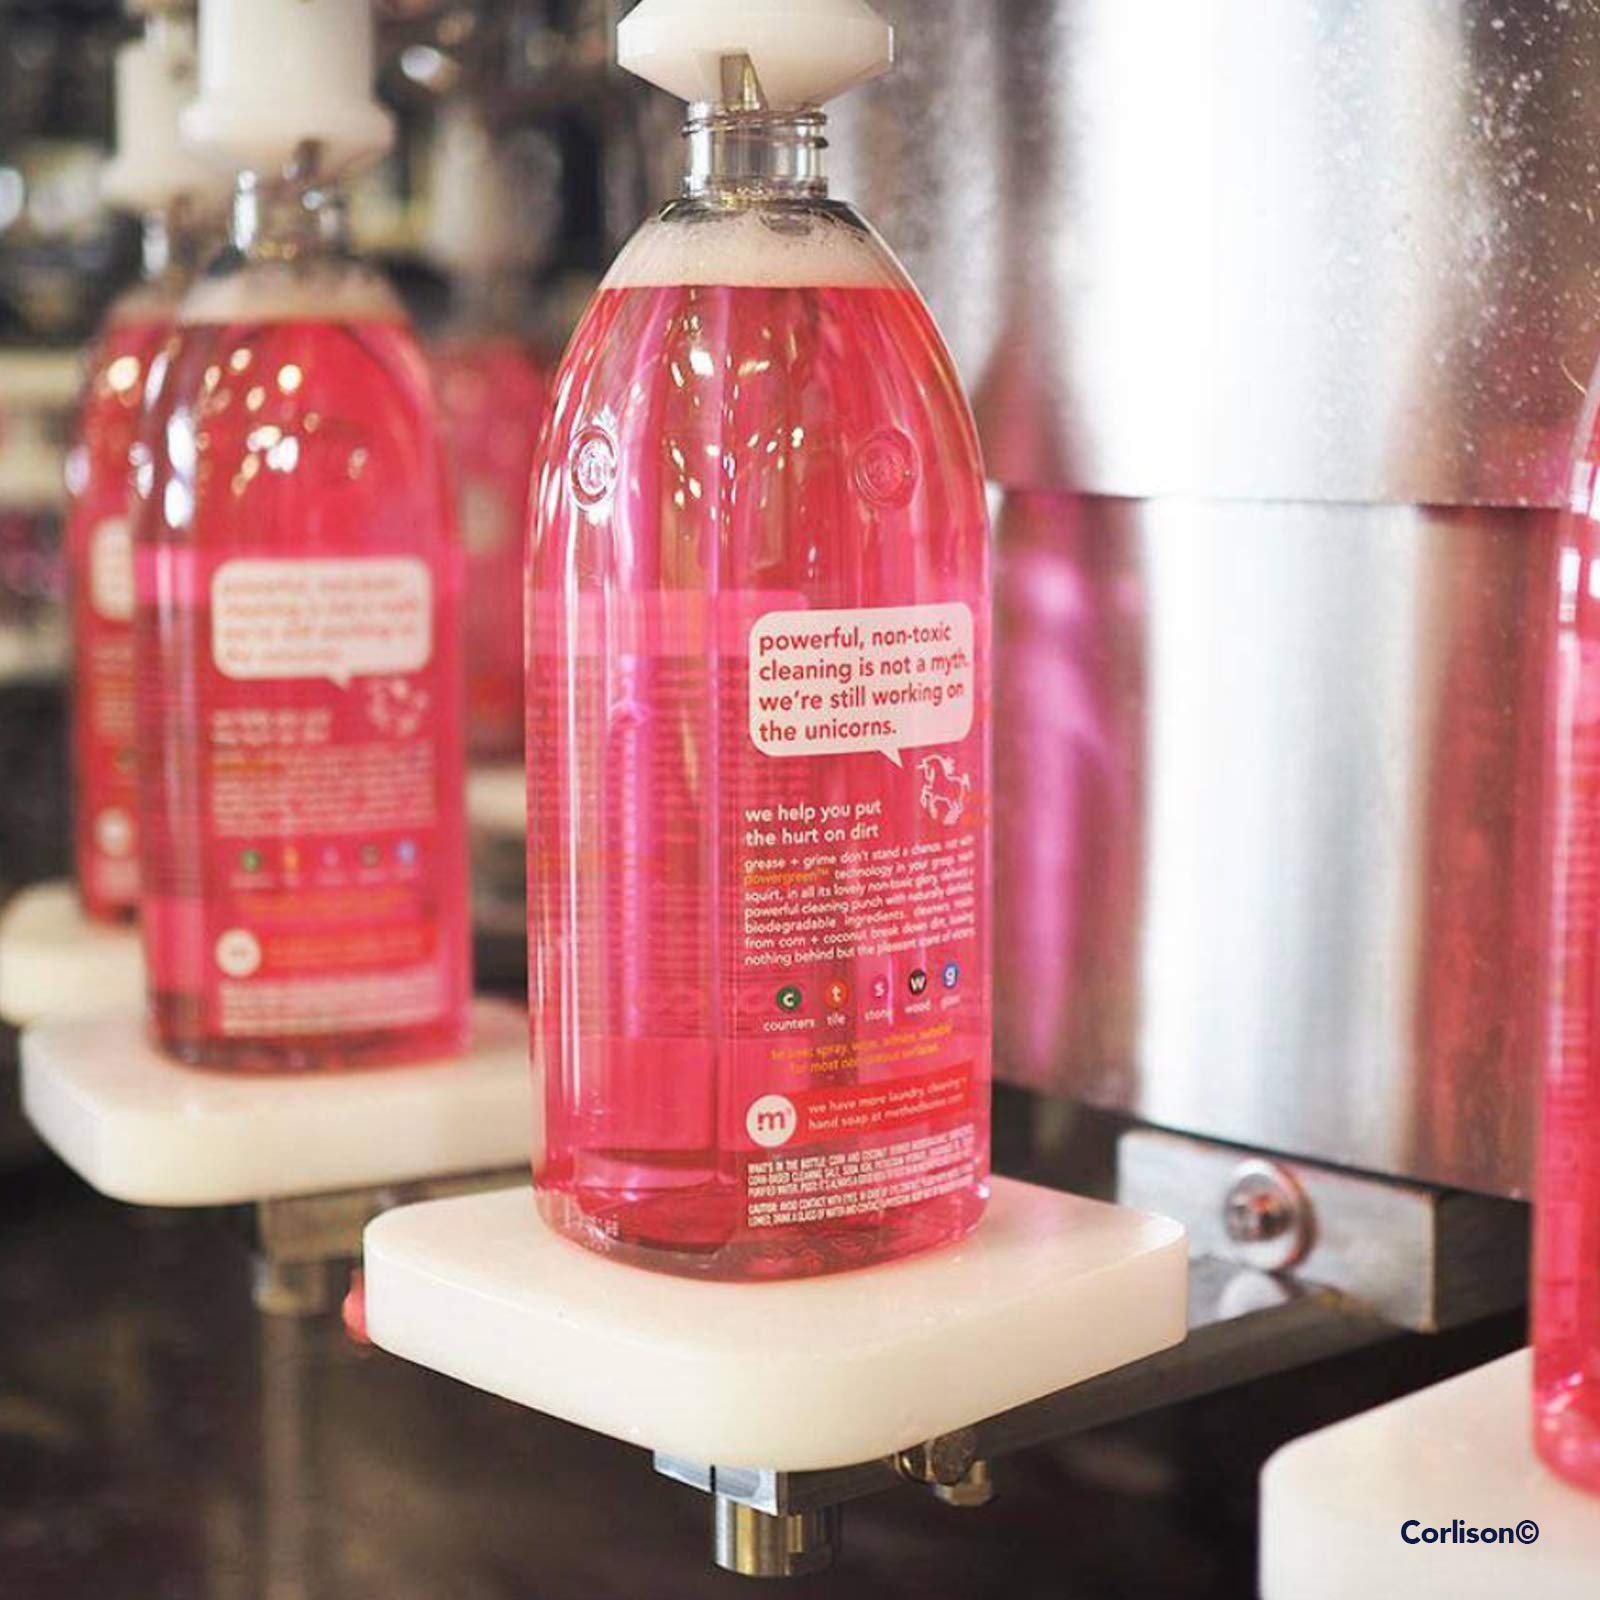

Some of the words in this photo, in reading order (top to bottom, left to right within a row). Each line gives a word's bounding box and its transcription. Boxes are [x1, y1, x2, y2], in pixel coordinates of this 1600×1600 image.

[759, 626, 865, 656] powerful,
[872, 623, 952, 647] non-toxic
[759, 659, 852, 684] cleaning
[859, 657, 875, 677] is
[880, 657, 911, 676] not
[916, 661, 926, 674] a
[931, 647, 969, 677] myth.
[759, 690, 823, 711] we're
[830, 685, 866, 709] still
[872, 683, 943, 707] working
[947, 682, 964, 700] on
[759, 720, 797, 742] the
[805, 719, 897, 741] unicorns.
[745, 808, 773, 822] we
[778, 803, 816, 823] help
[821, 804, 851, 823] you
[855, 801, 882, 819] put
[745, 829, 776, 846] the
[782, 827, 819, 844] hurt
[824, 826, 845, 841] on
[851, 824, 880, 840] dirt
[744, 859, 785, 874] grease
[803, 854, 837, 870] grime
[801, 885, 815, 898] all
[834, 881, 867, 897] lovely
[744, 902, 799, 920] powerful
[802, 902, 849, 917] cleaning
[850, 896, 883, 913] punch
[744, 916, 837, 935] biodegradable
[745, 937, 774, 949] from
[779, 937, 805, 949] corn
[824, 930, 867, 944] coconut
[744, 952, 792, 967] nothing
[794, 948, 835, 963] behind
[836, 945, 855, 957] but
[764, 1018, 816, 1032] counters
[826, 1013, 846, 1026] tile
[808, 1103, 826, 1114] we
[829, 1098, 857, 1112] have
[858, 1094, 887, 1107] more
[808, 1116, 838, 1130] hand
[841, 1113, 870, 1128] soap
